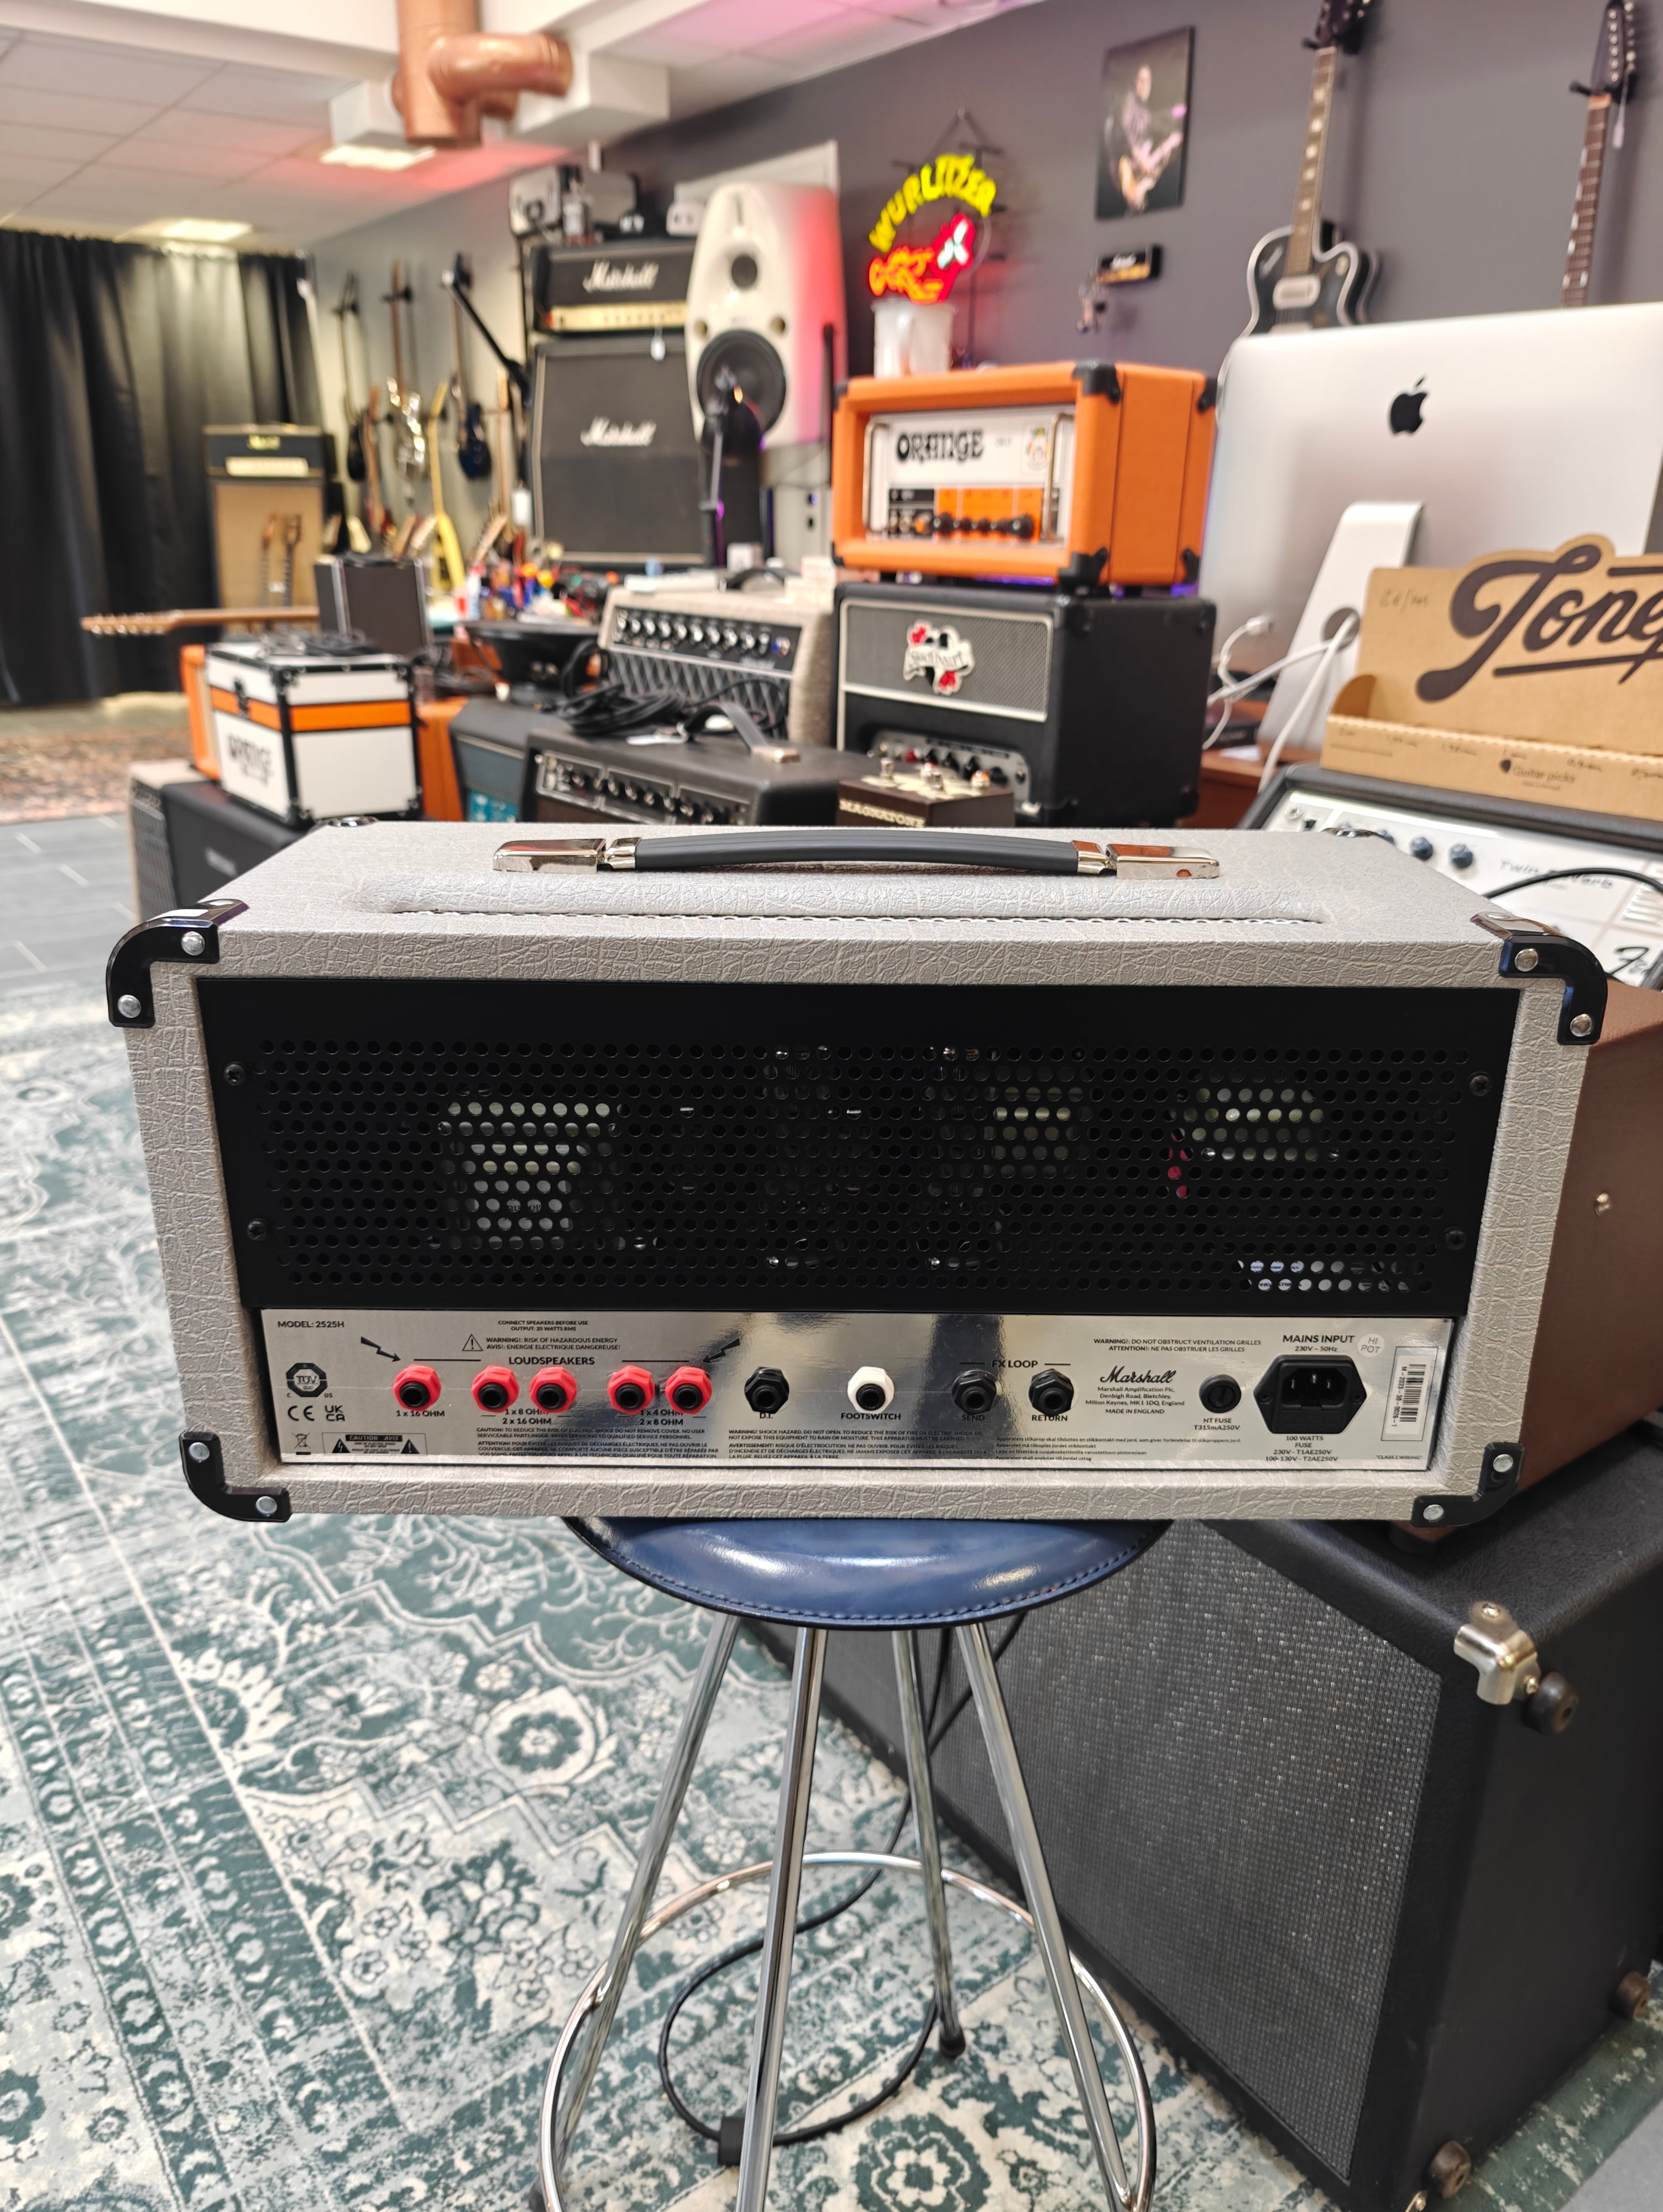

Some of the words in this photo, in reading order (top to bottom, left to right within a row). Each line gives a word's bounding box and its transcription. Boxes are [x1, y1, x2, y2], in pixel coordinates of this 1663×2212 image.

[1415, 544, 1663, 702] Tone
[509, 1357, 595, 1365] LOUDSPEAKERS
[1100, 1365, 1176, 1383] Marshall
[287, 1405, 315, 1421] CE
